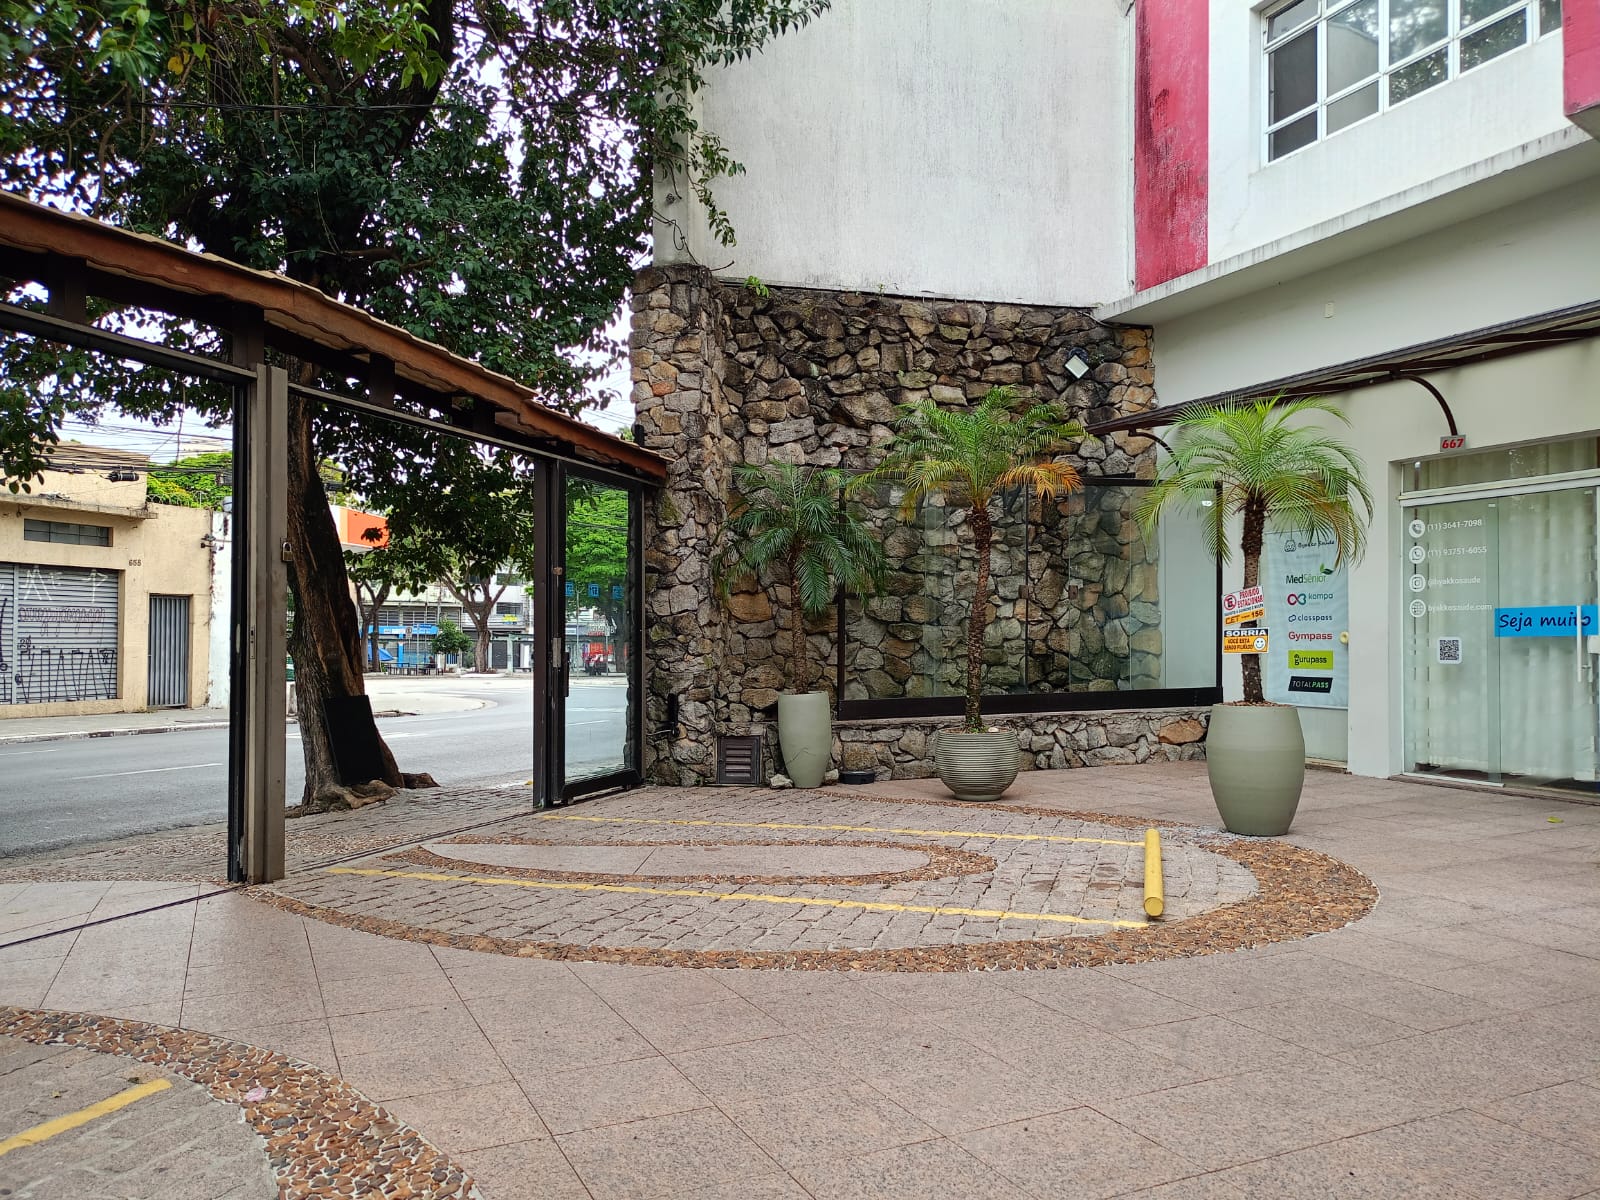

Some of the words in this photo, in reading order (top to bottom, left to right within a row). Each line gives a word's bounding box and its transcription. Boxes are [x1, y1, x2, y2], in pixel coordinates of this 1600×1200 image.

[1442, 438, 1464, 449] 667
[1427, 522, 1441, 532] (11)
[1442, 519, 1482, 529] 3641-7098
[1427, 549, 1441, 559] (11)
[1443, 545, 1487, 556] 93751-6055
[1225, 615, 1240, 625] CET
[1499, 612, 1532, 632] Seja
[1225, 629, 1267, 637] SORRIA
[1288, 631, 1333, 642] Gympass
